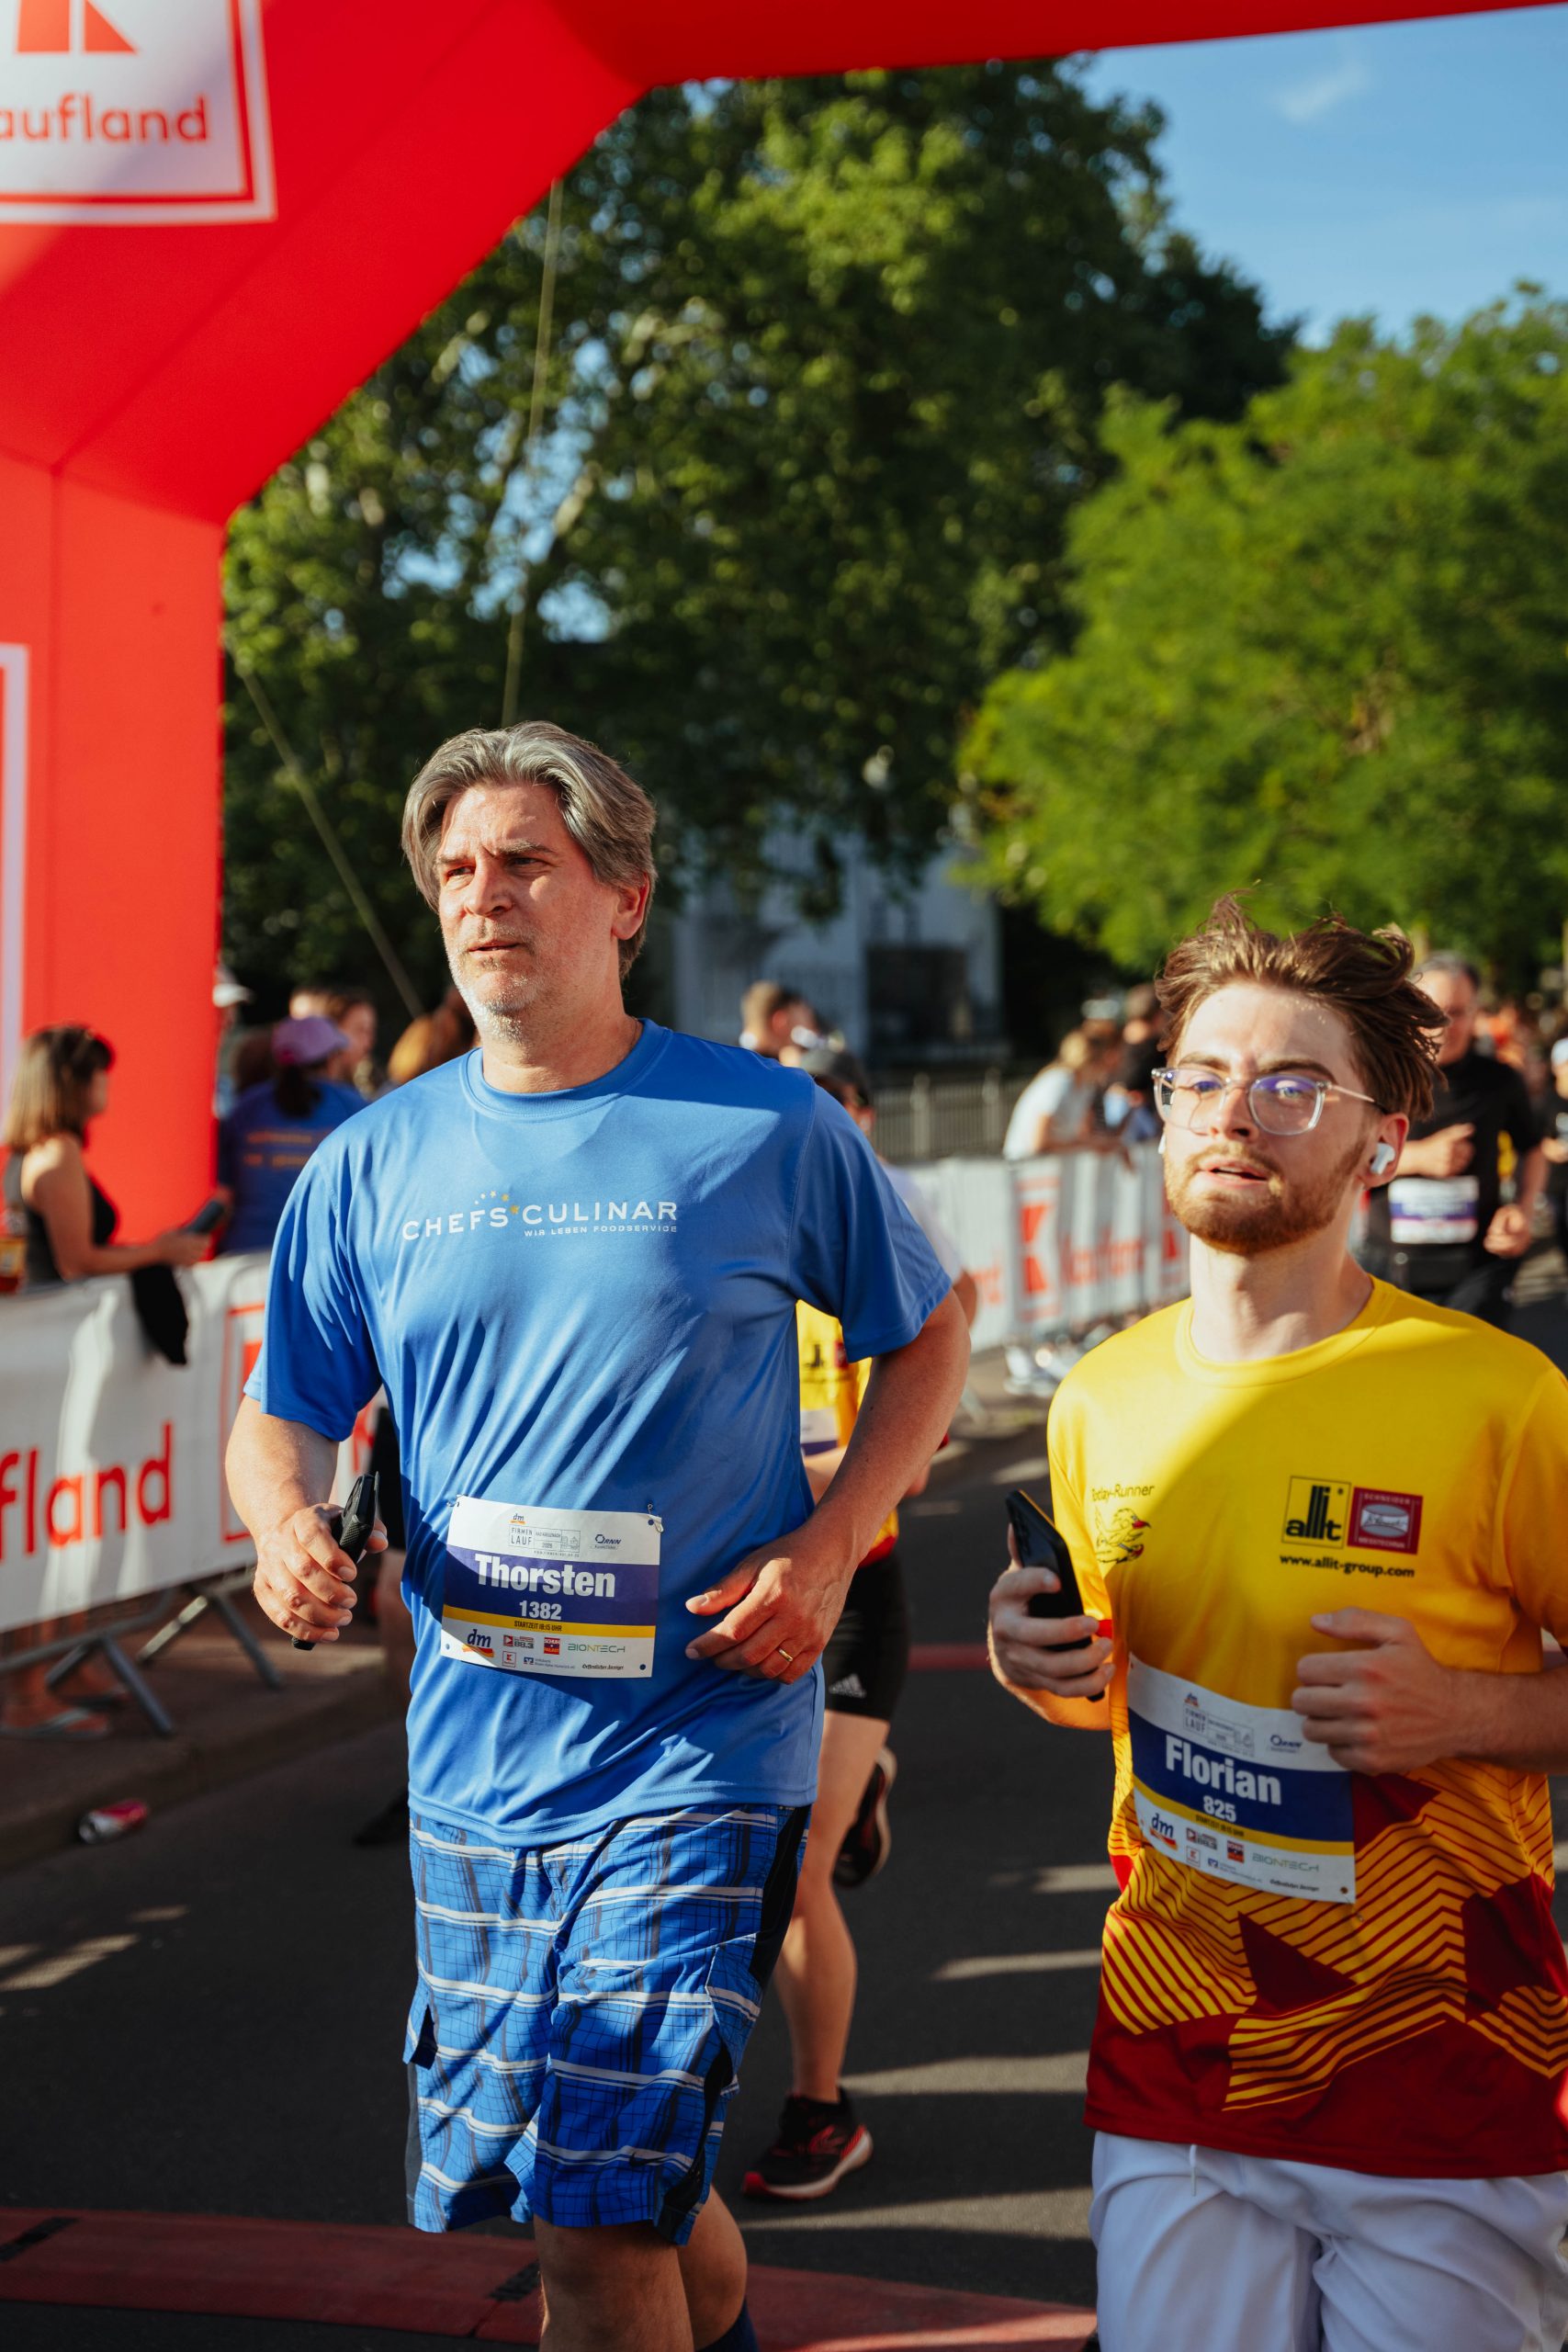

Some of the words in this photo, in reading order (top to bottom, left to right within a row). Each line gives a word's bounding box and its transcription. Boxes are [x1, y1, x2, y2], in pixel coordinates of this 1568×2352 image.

[402, 1206, 509, 1240] CHEFS
[522, 1201, 677, 1225] CULINAR
[551, 1227, 588, 1235] LEBEN
[593, 1225, 677, 1233] FOODSERVICE
[1286, 1485, 1341, 1542] allit
[511, 1535, 532, 1545] LAUF
[475, 1554, 615, 1598] Thorsten
[1280, 1555, 1415, 1578] www.allit-group.com
[519, 1600, 562, 1621] 1382
[514, 1620, 538, 1630] STARTZEIT
[467, 1629, 491, 1647] dm
[568, 1644, 626, 1653] BIONTECH
[1166, 1735, 1282, 1805] Florian
[1203, 1795, 1236, 1823] 825
[1151, 1813, 1174, 1838] dm
